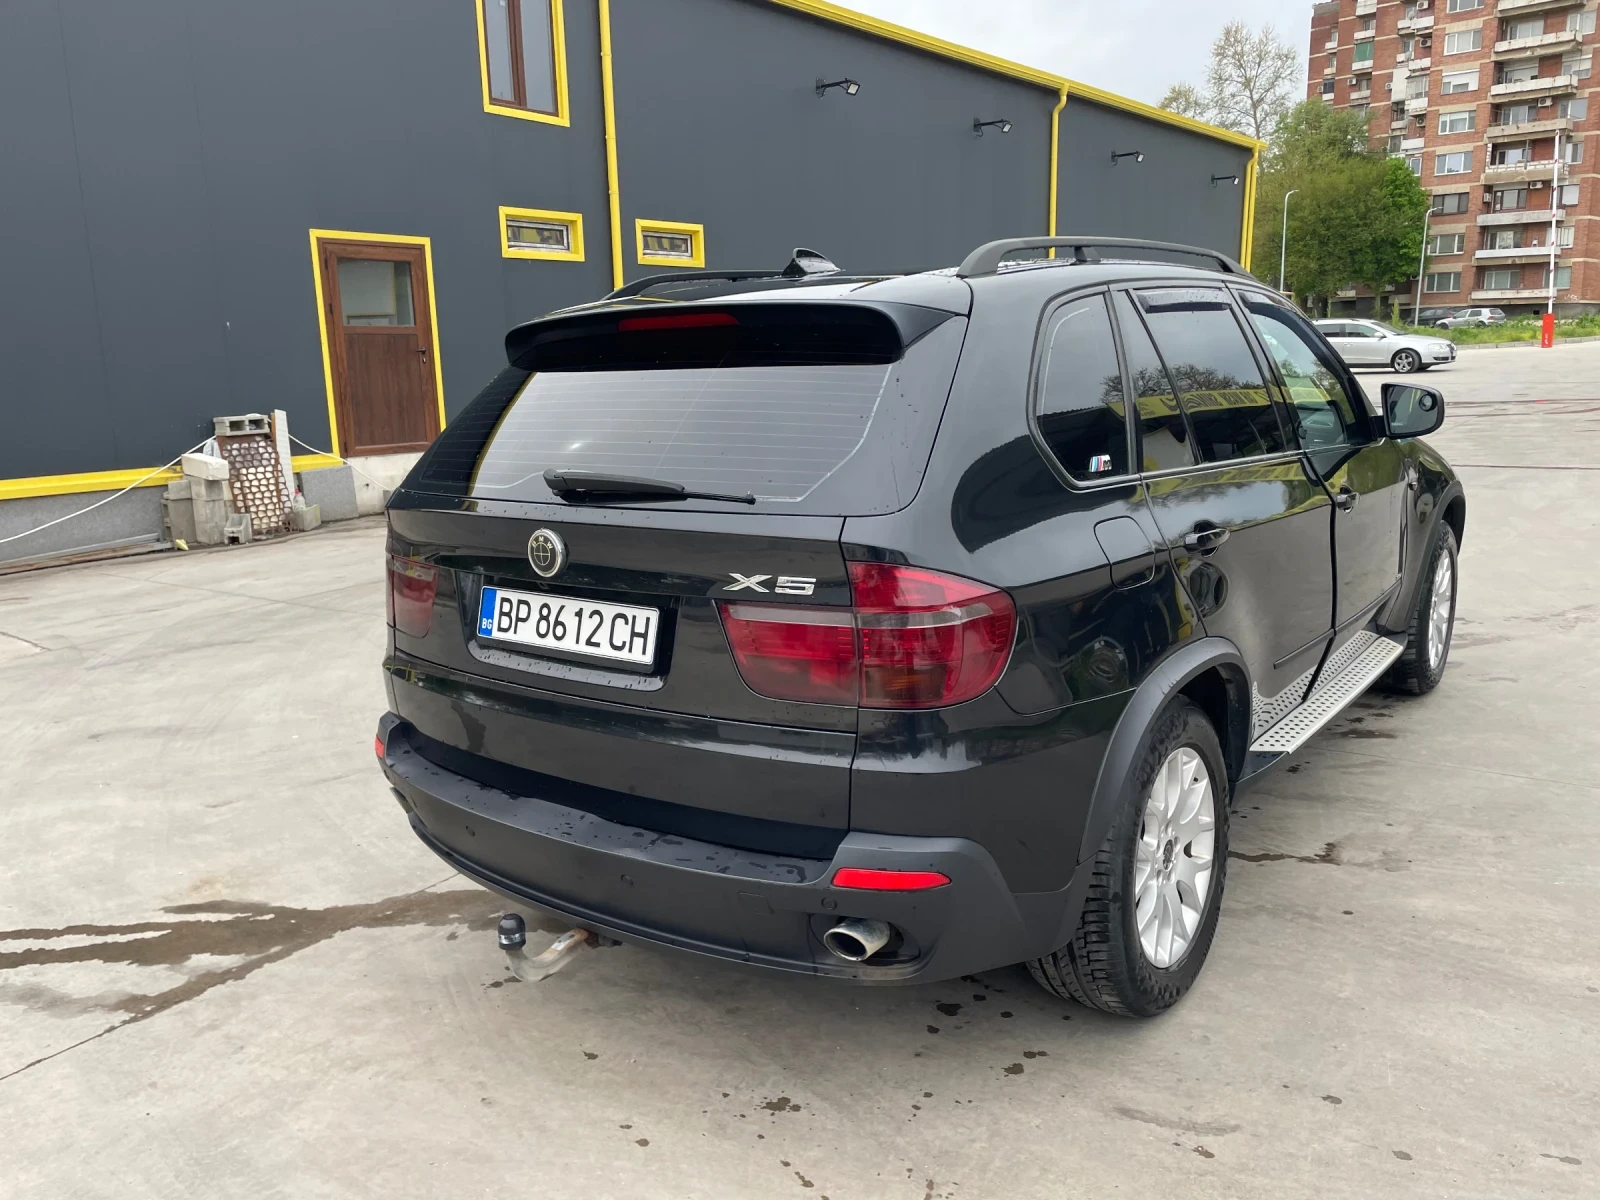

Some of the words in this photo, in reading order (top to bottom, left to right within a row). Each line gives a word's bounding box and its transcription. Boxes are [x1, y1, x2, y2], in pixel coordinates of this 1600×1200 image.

[531, 535, 553, 549] BMW
[722, 572, 817, 596] X5
[481, 617, 493, 630] BG
[497, 596, 532, 635] BP
[535, 602, 604, 649] 8612
[608, 612, 651, 656] CH
